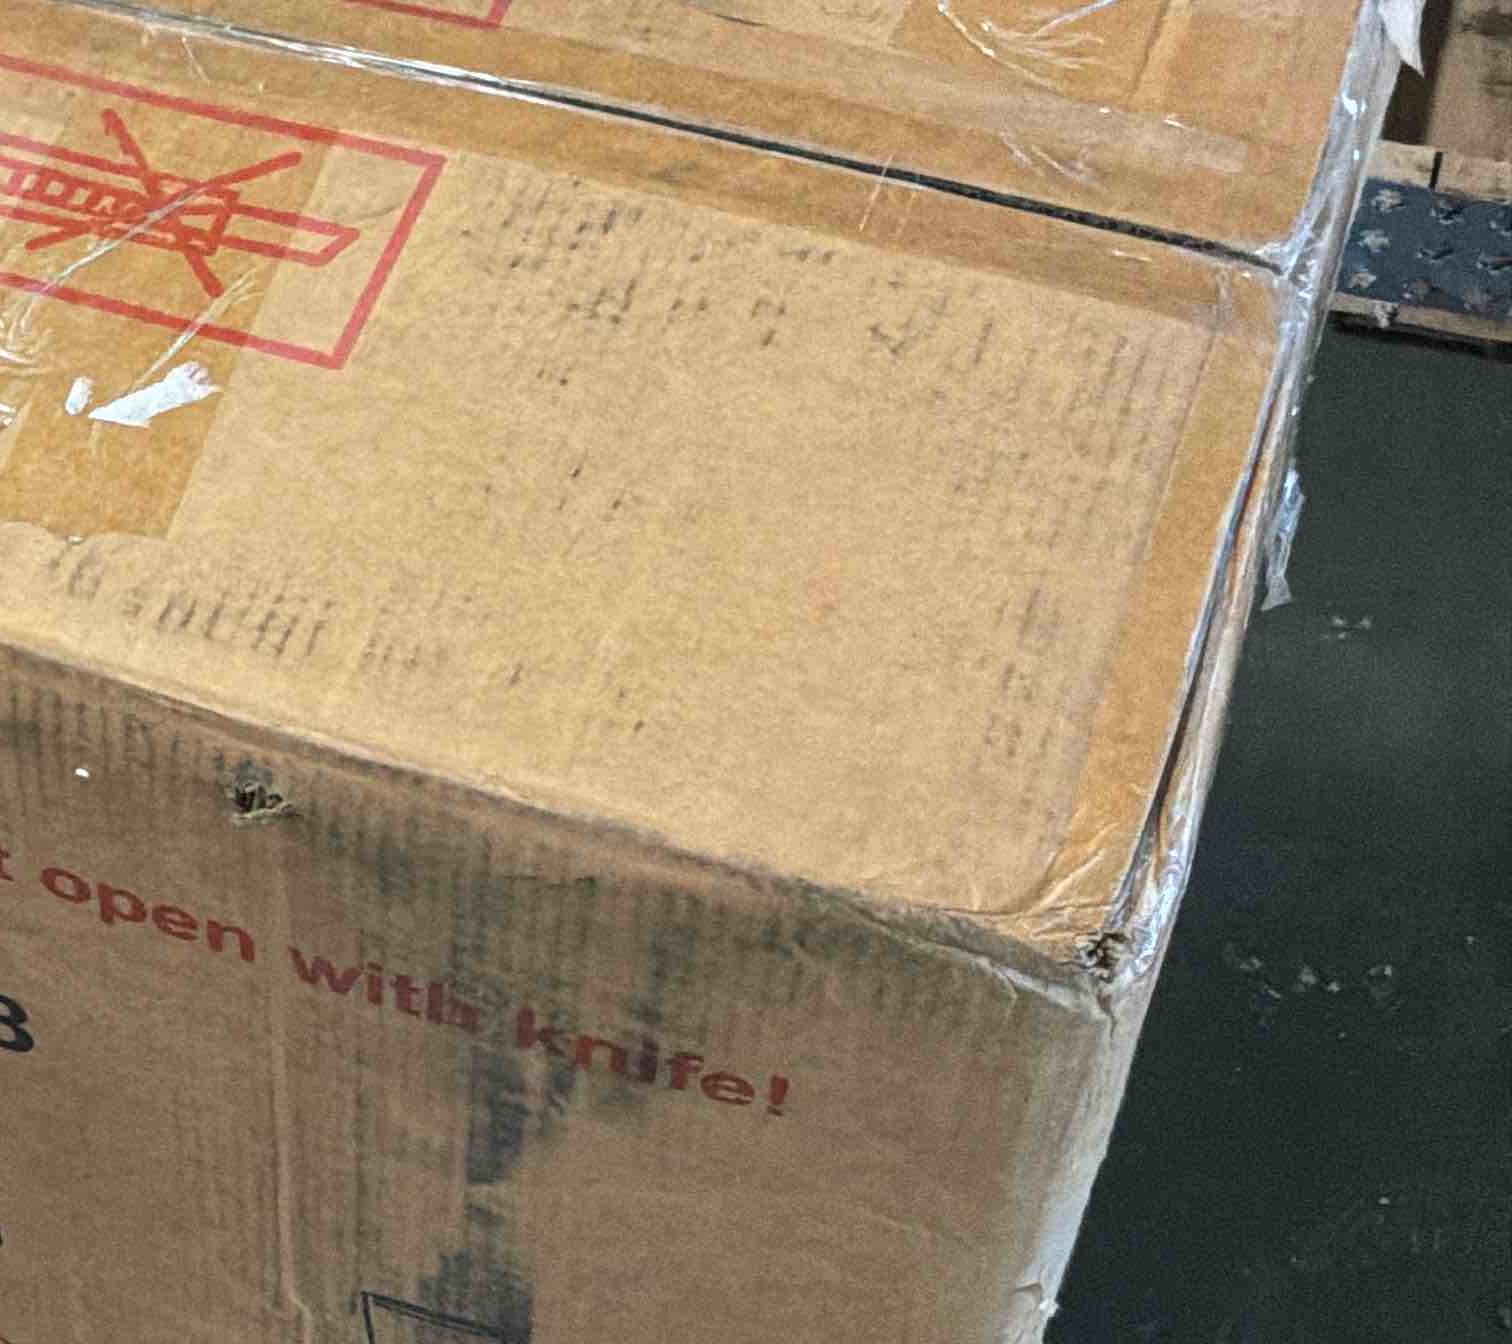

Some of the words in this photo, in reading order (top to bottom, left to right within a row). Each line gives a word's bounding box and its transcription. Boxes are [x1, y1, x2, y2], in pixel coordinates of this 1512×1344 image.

[39, 867, 256, 962] open
[289, 945, 482, 1033] with
[515, 1007, 790, 1116] knife!
